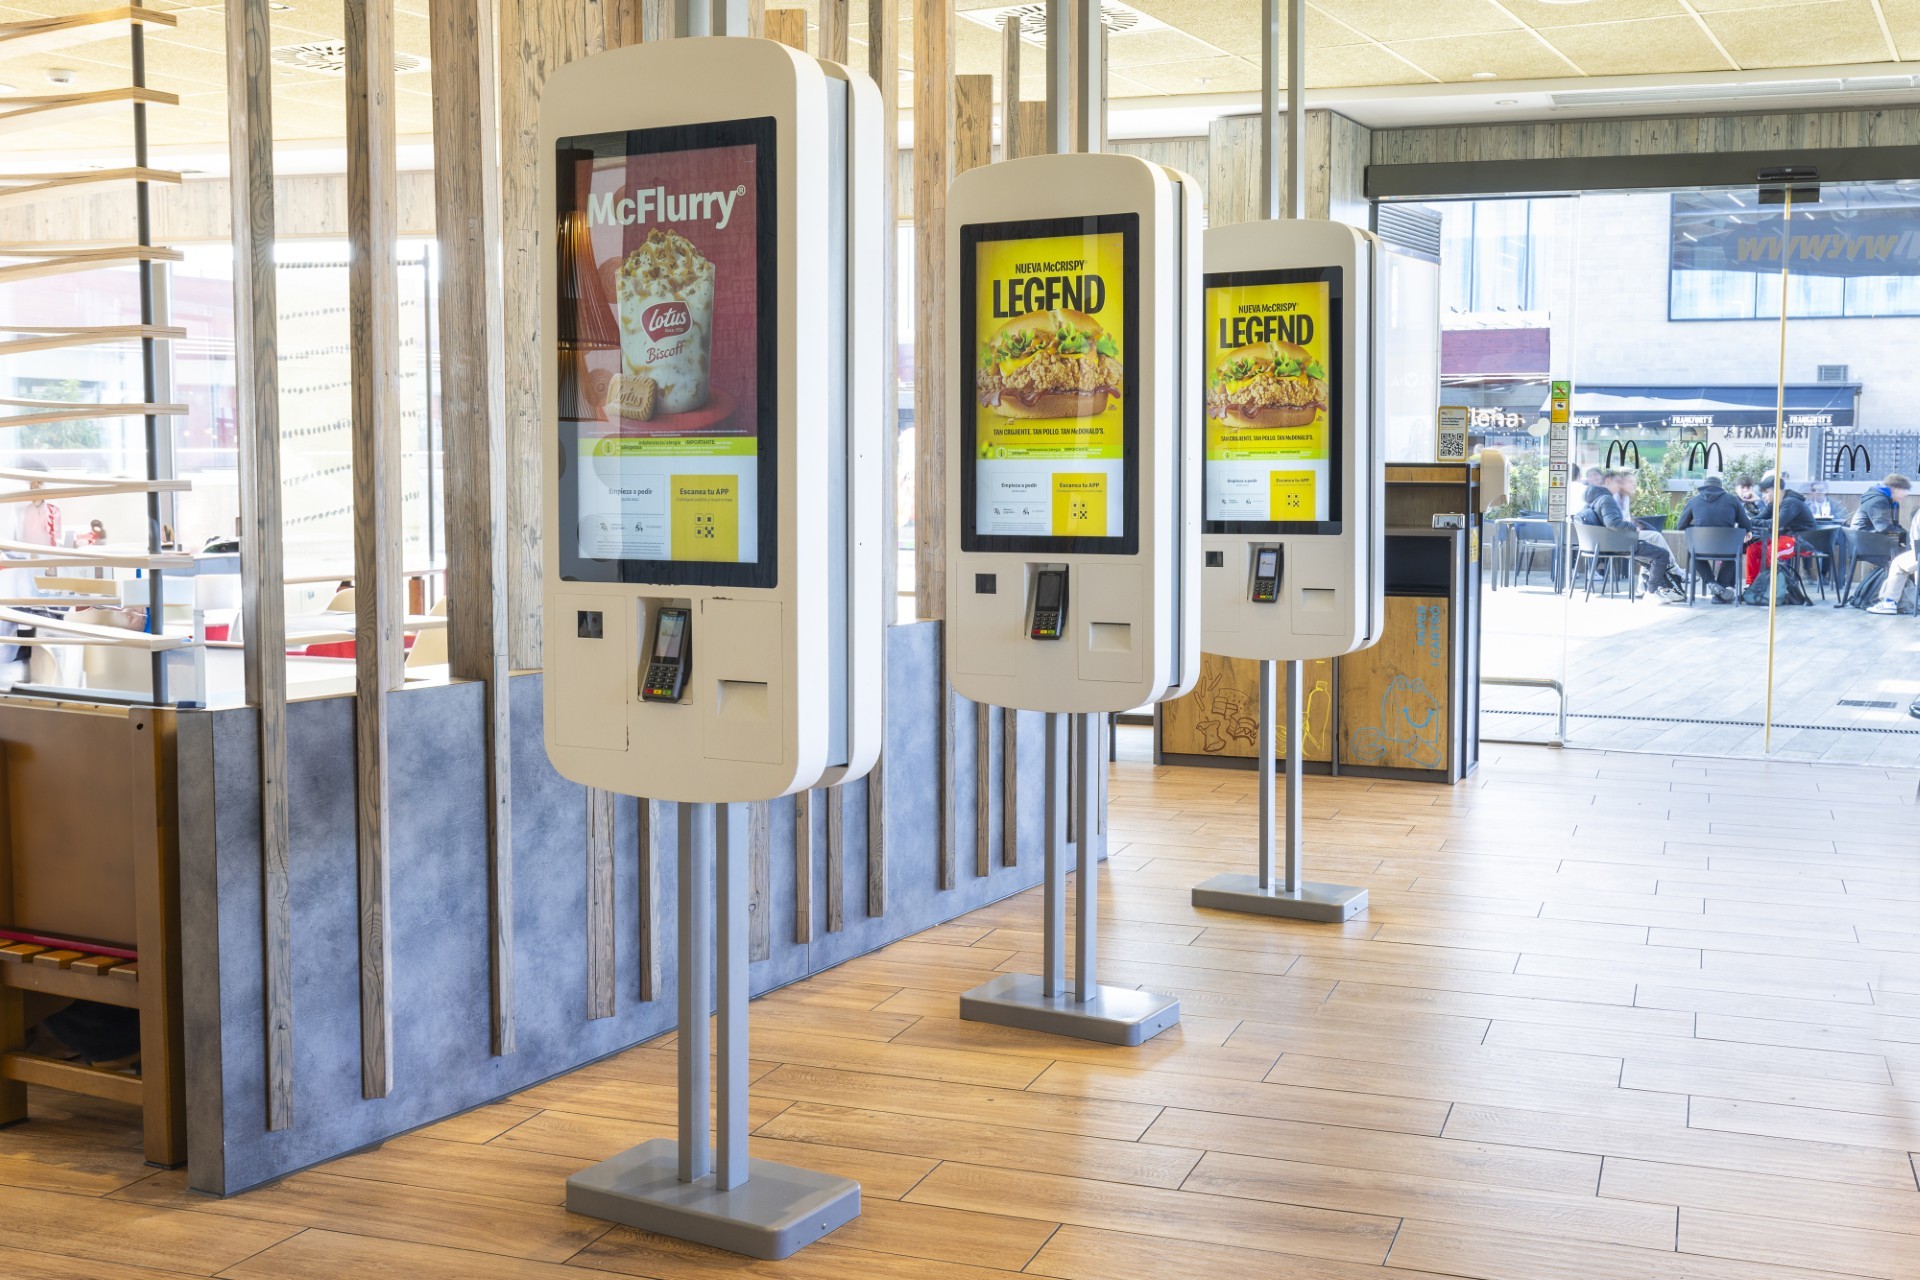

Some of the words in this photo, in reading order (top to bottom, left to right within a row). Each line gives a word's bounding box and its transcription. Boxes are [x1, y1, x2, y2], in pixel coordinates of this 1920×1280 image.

[1015, 262, 1042, 274] NUEVA
[993, 274, 1105, 318] LEGEND
[649, 307, 687, 332] Lotus
[1238, 305, 1260, 314] NUEVA
[1220, 314, 1314, 348] LEGEND
[646, 339, 686, 364] Biscoff
